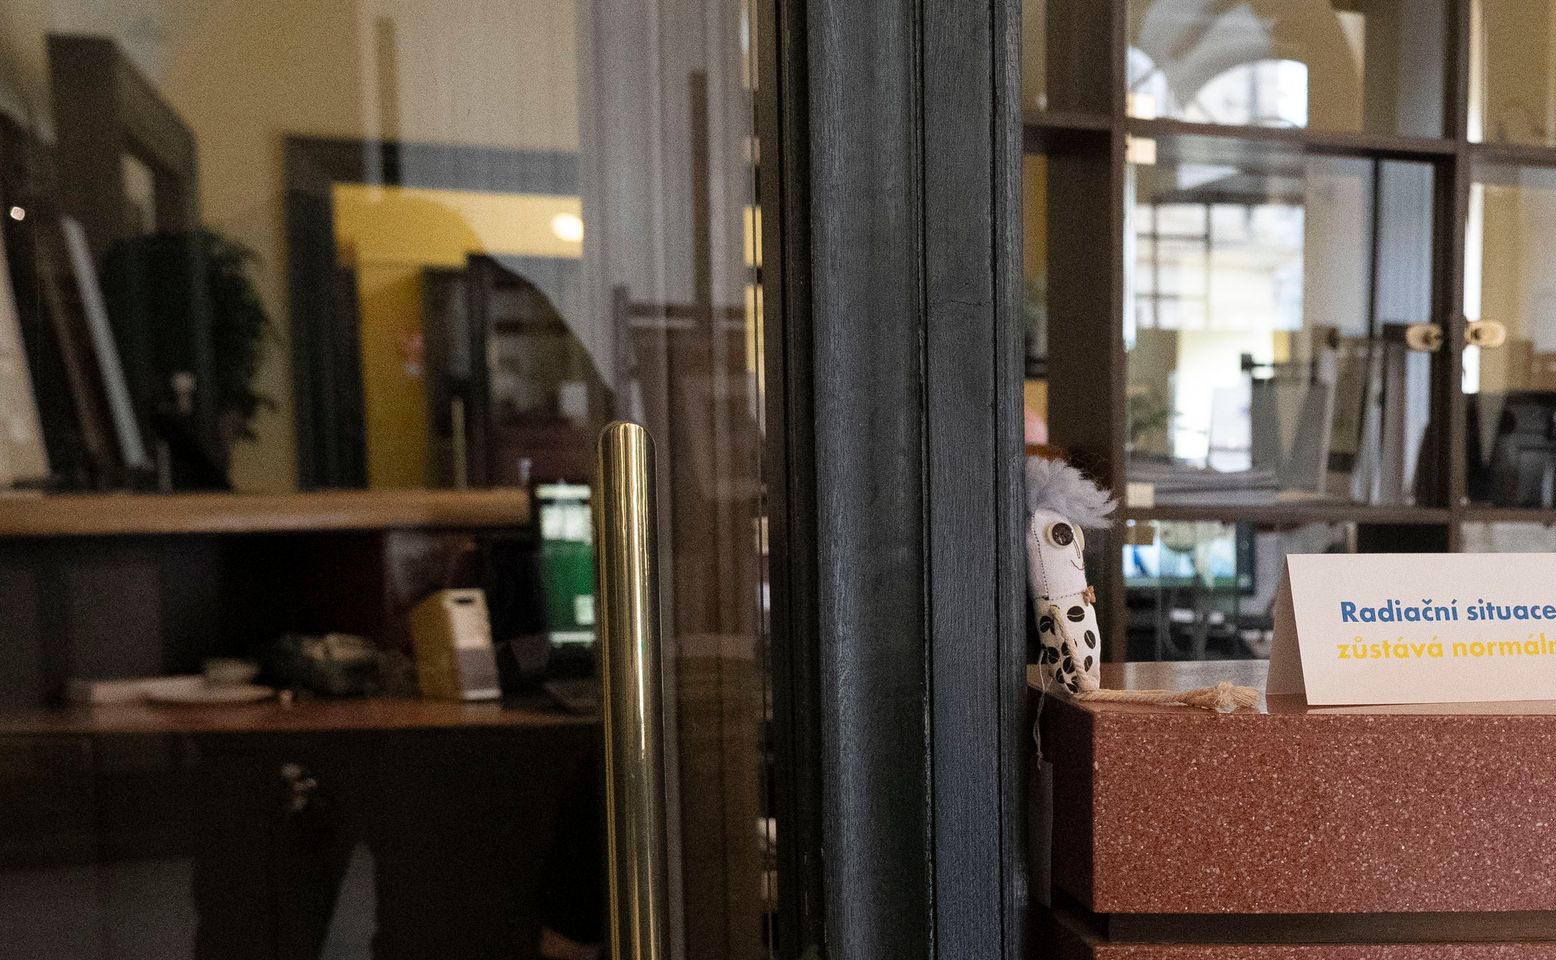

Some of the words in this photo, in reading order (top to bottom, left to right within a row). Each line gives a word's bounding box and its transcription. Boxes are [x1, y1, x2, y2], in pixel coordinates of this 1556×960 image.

[1340, 598, 1459, 623] Radiační
[1466, 598, 1556, 621] situace
[1336, 635, 1444, 660] zůstává
